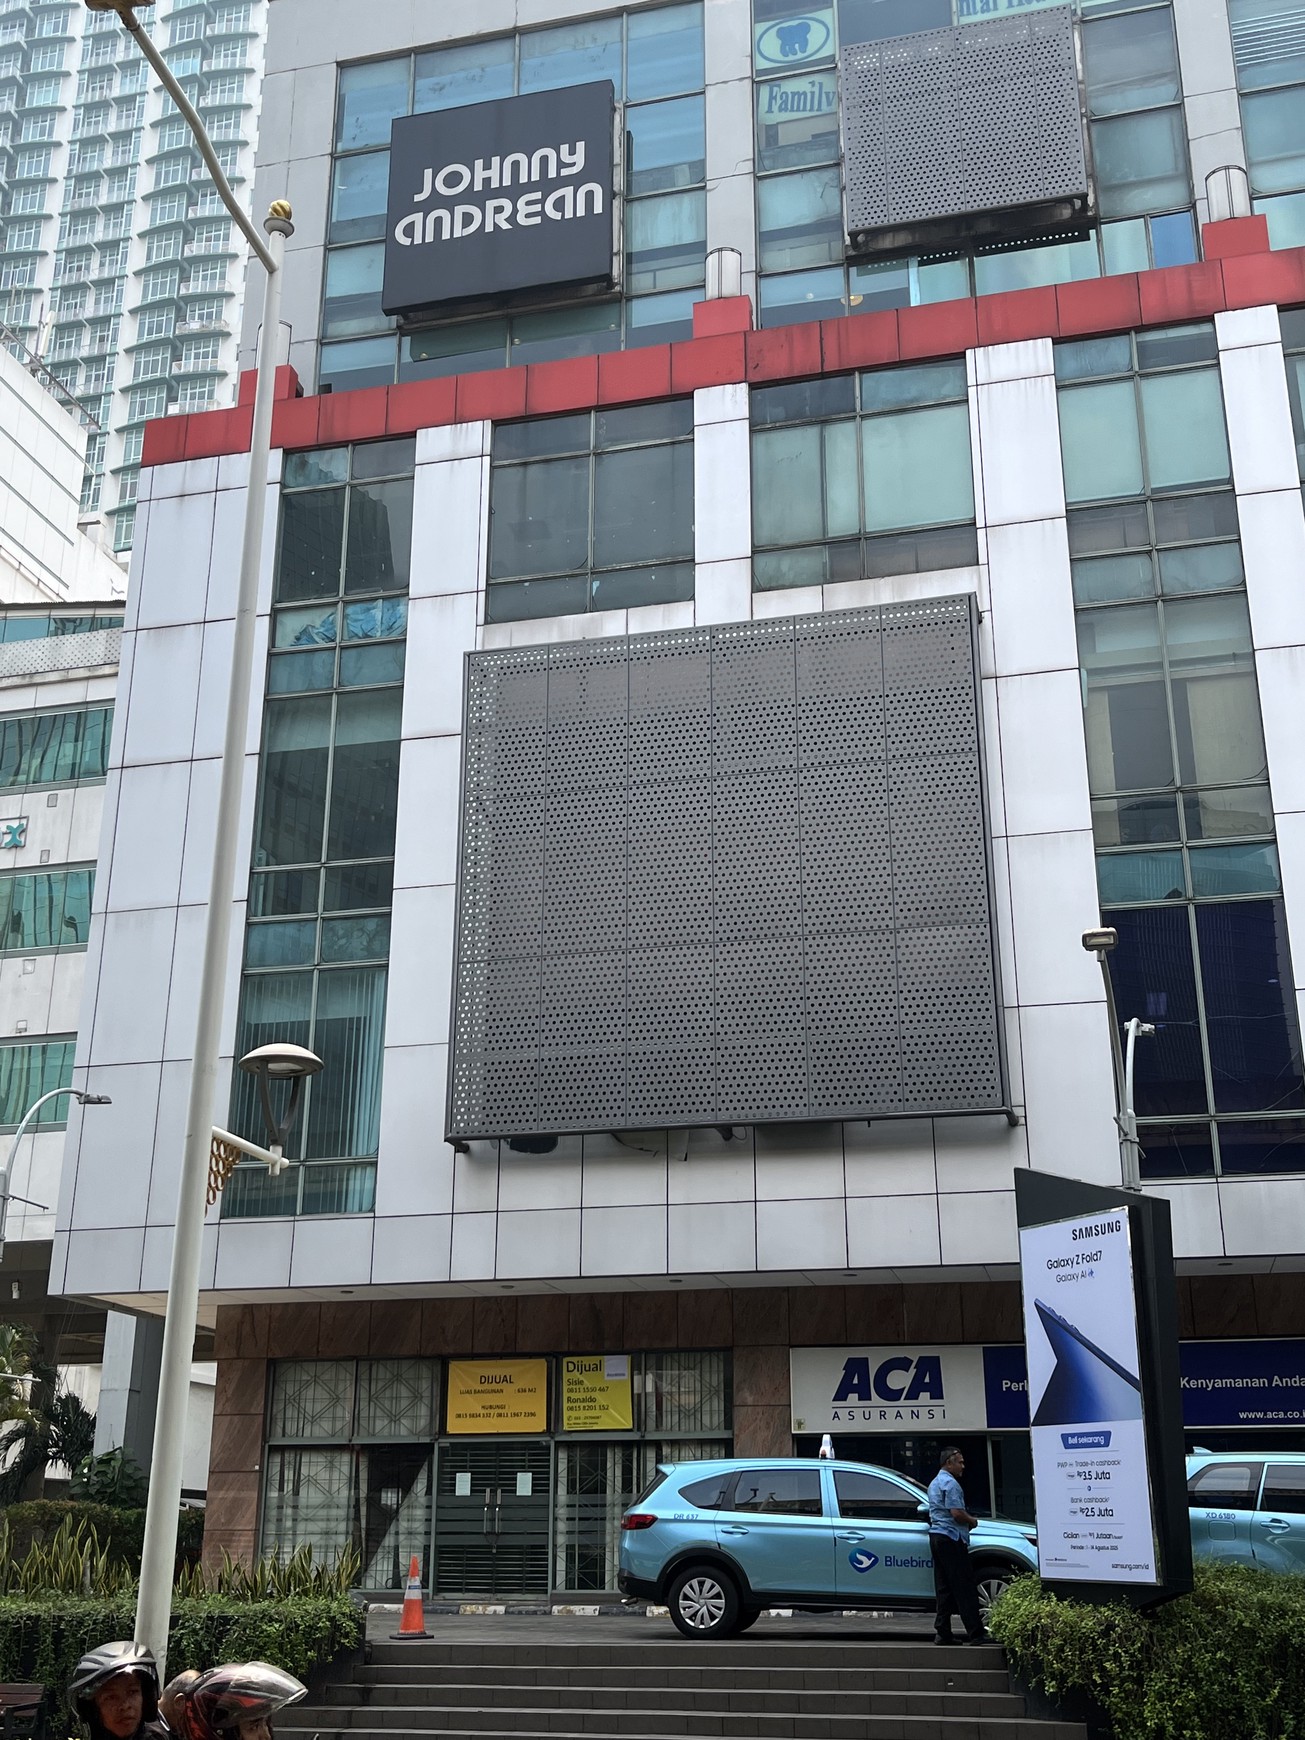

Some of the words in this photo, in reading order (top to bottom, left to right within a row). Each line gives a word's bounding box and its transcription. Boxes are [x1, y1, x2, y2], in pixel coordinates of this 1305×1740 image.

[413, 140, 585, 203] JOHNNY
[394, 182, 603, 246] ANDREAN
[1071, 1220, 1121, 1241] SAMSUNG
[1046, 1258, 1075, 1270] Galaxy
[1075, 1254, 1080, 1265] Z
[1081, 1250, 1103, 1264] Fold7
[1056, 1270, 1080, 1283] Galaxy
[566, 1360, 602, 1375] Dijual
[480, 1374, 514, 1385] DIJUAL
[567, 1378, 584, 1386] Sisie
[831, 1355, 944, 1402] ACA
[1179, 1377, 1268, 1391] Kenyamanan
[567, 1395, 597, 1404] Ronaldo
[831, 1409, 946, 1421] ASURANSI
[1093, 1470, 1111, 1480] Juta
[1096, 1507, 1114, 1517] Juta
[884, 1555, 934, 1569] Bluebird
